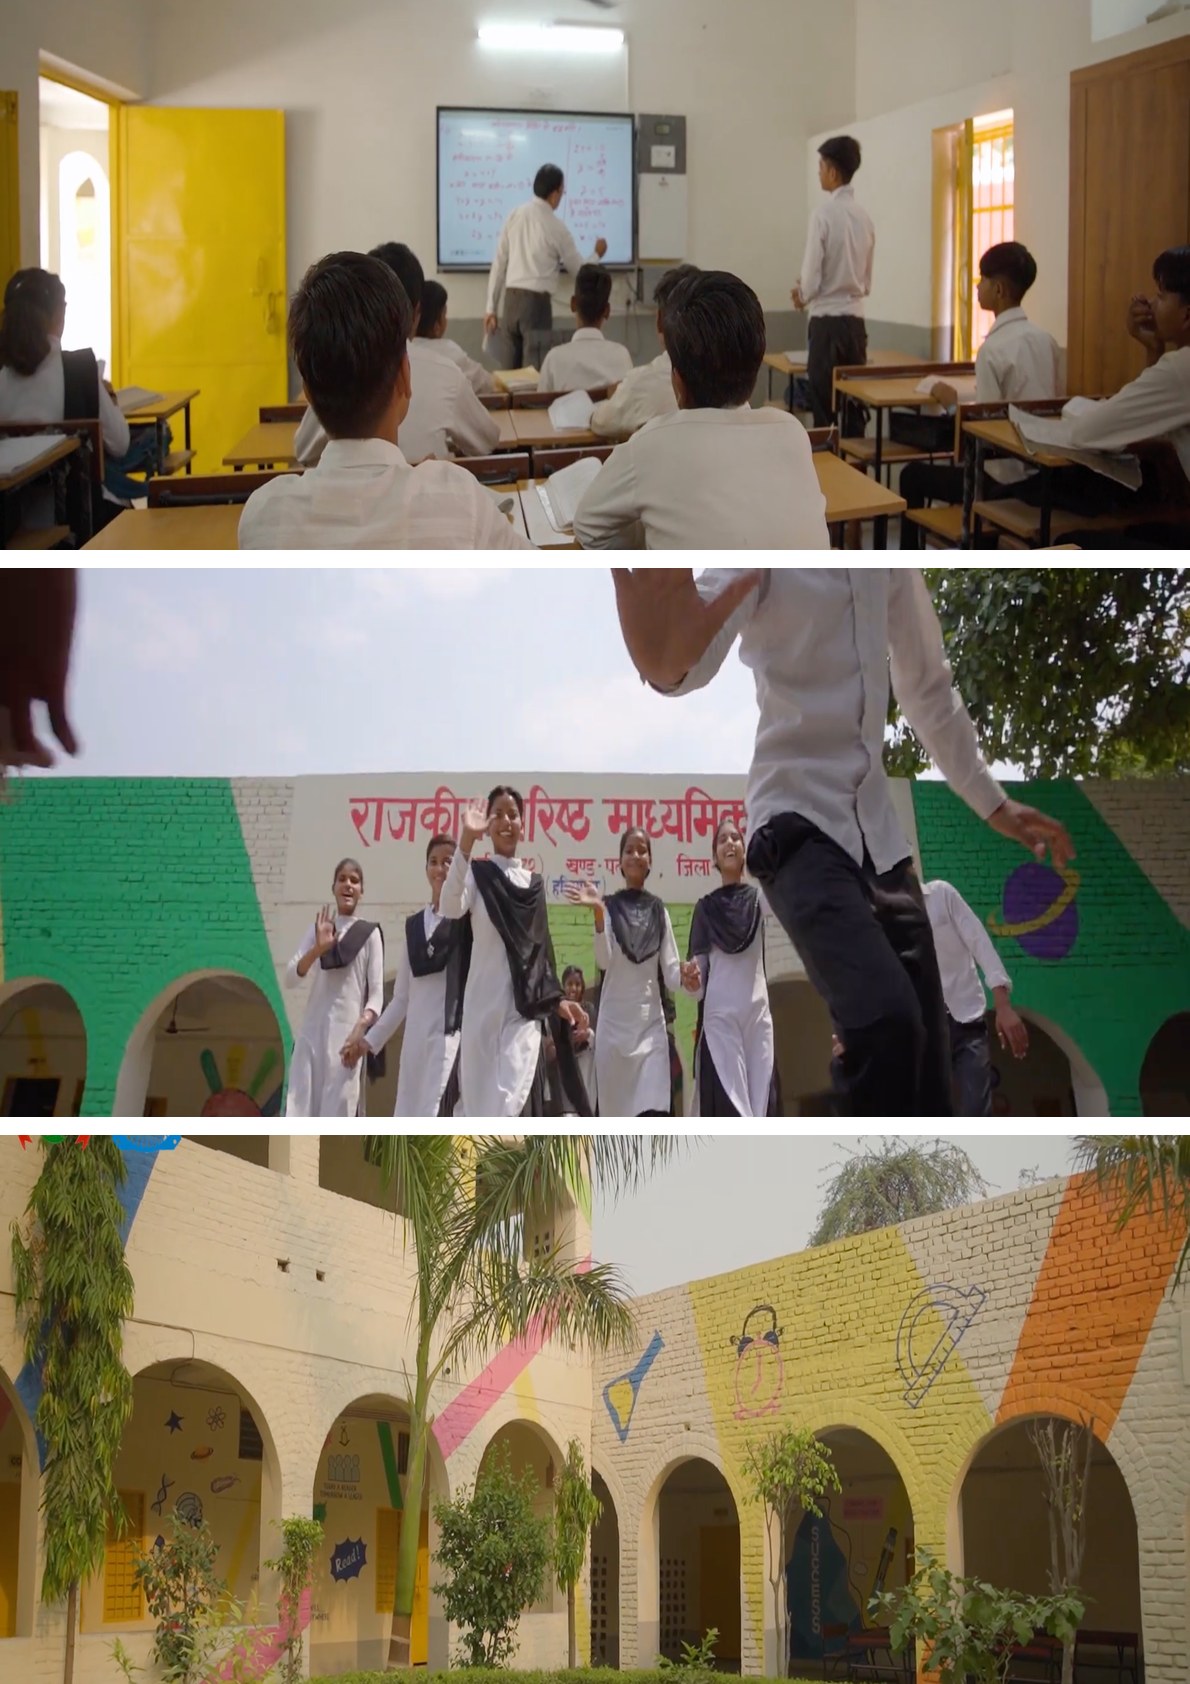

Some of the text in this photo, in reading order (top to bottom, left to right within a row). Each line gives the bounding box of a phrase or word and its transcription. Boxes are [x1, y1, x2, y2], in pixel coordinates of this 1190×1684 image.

[349, 786, 484, 847] राजकी
[518, 785, 593, 847] रिष्ठ
[335, 1544, 361, 1573] Read!
[811, 1525, 821, 1634] SUCCESS
